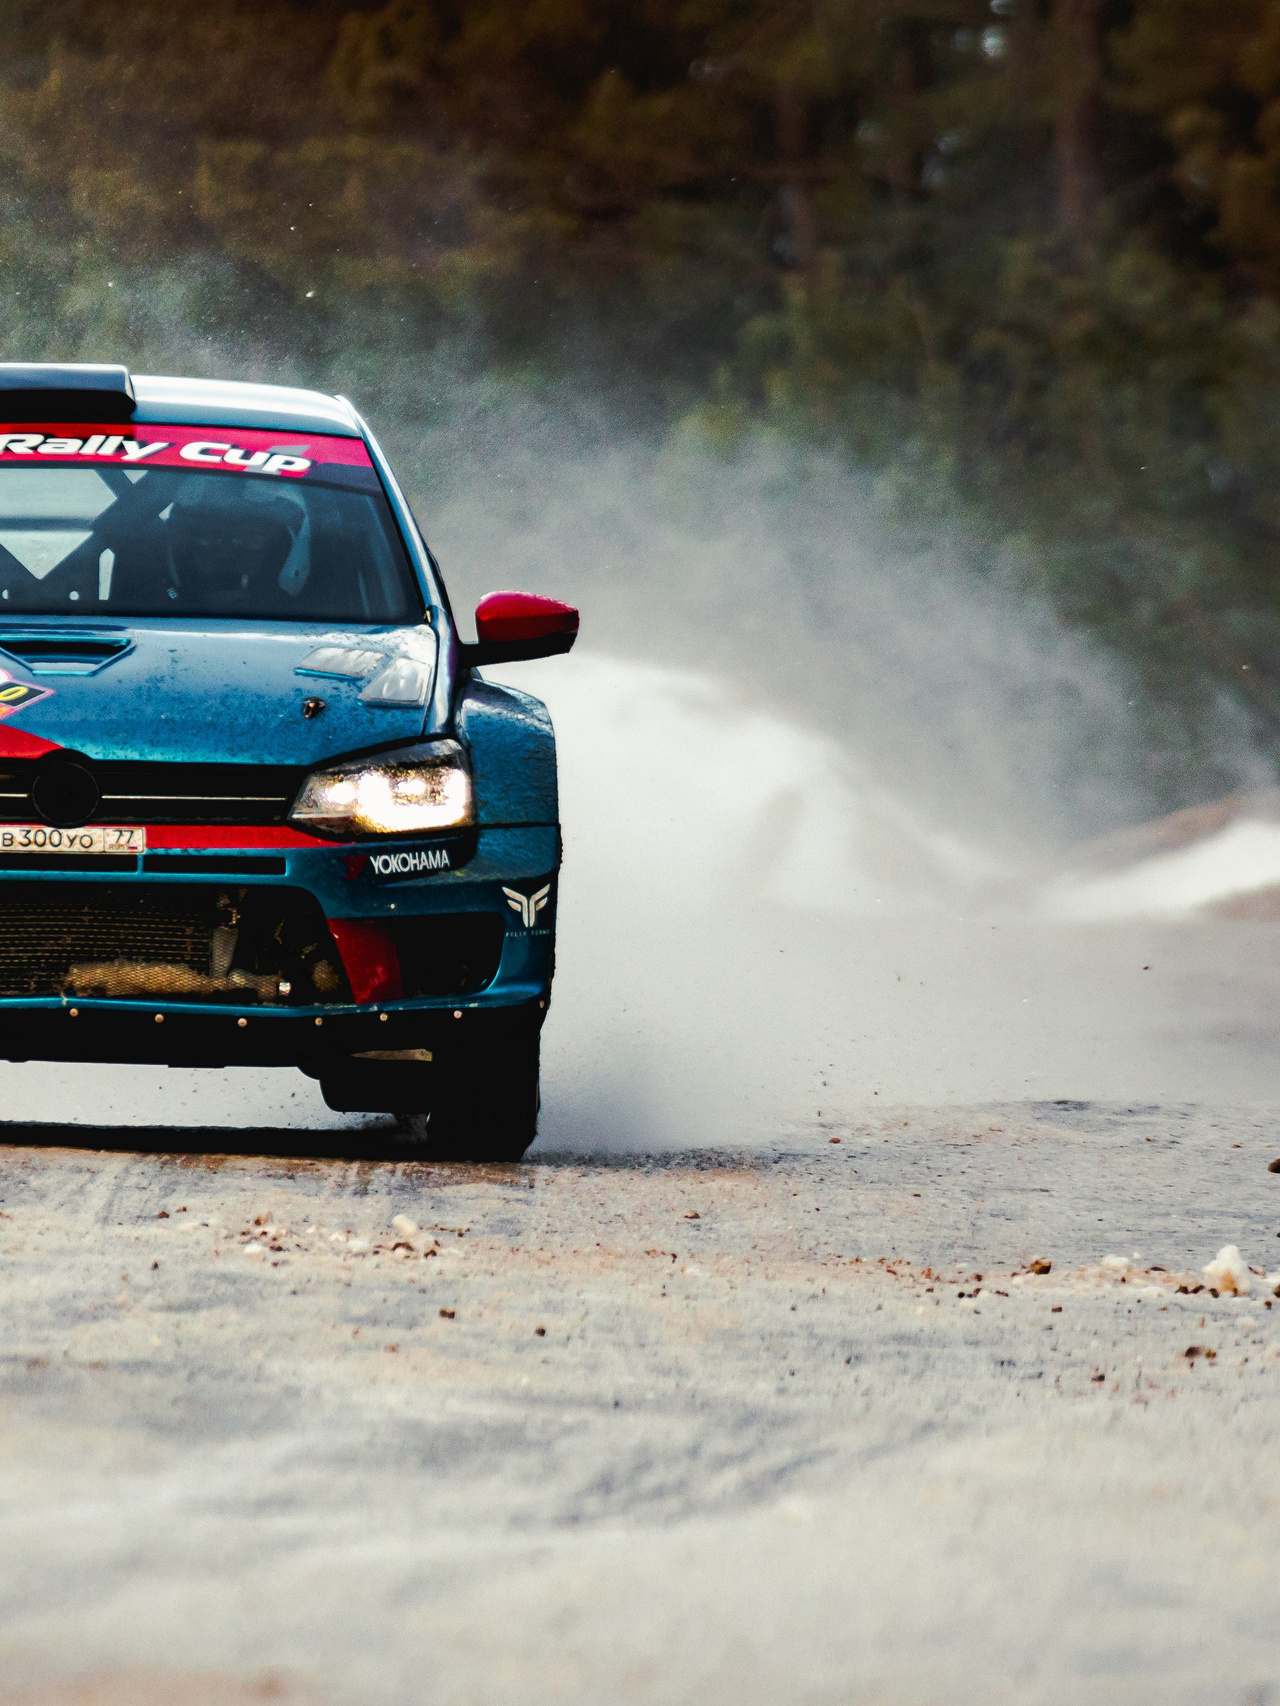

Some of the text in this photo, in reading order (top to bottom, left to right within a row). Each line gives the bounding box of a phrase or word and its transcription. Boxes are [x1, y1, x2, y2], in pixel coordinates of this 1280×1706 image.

[179, 441, 312, 473] Cup
[112, 829, 134, 843] 77
[369, 849, 450, 875] YOKOHAMA
